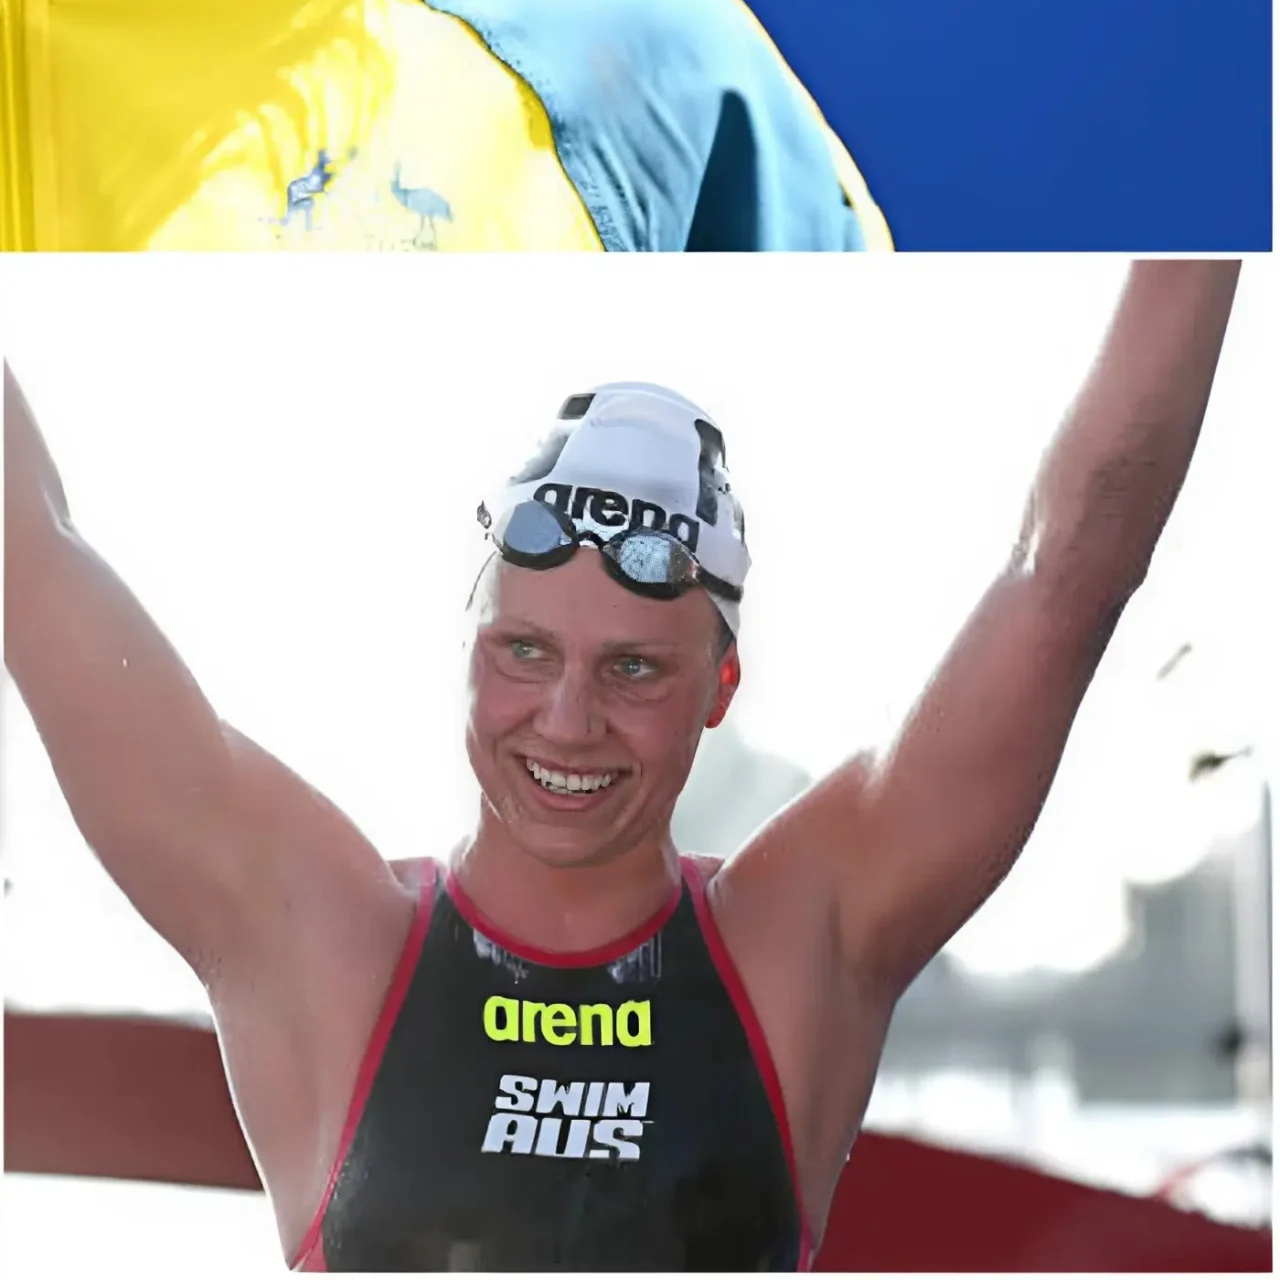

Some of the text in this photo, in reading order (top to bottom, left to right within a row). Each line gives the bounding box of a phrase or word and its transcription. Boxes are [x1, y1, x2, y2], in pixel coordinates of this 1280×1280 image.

[533, 482, 700, 554] arena
[483, 996, 652, 1047] arena
[495, 1074, 650, 1117] SWIM
[481, 1113, 644, 1159] AUS
